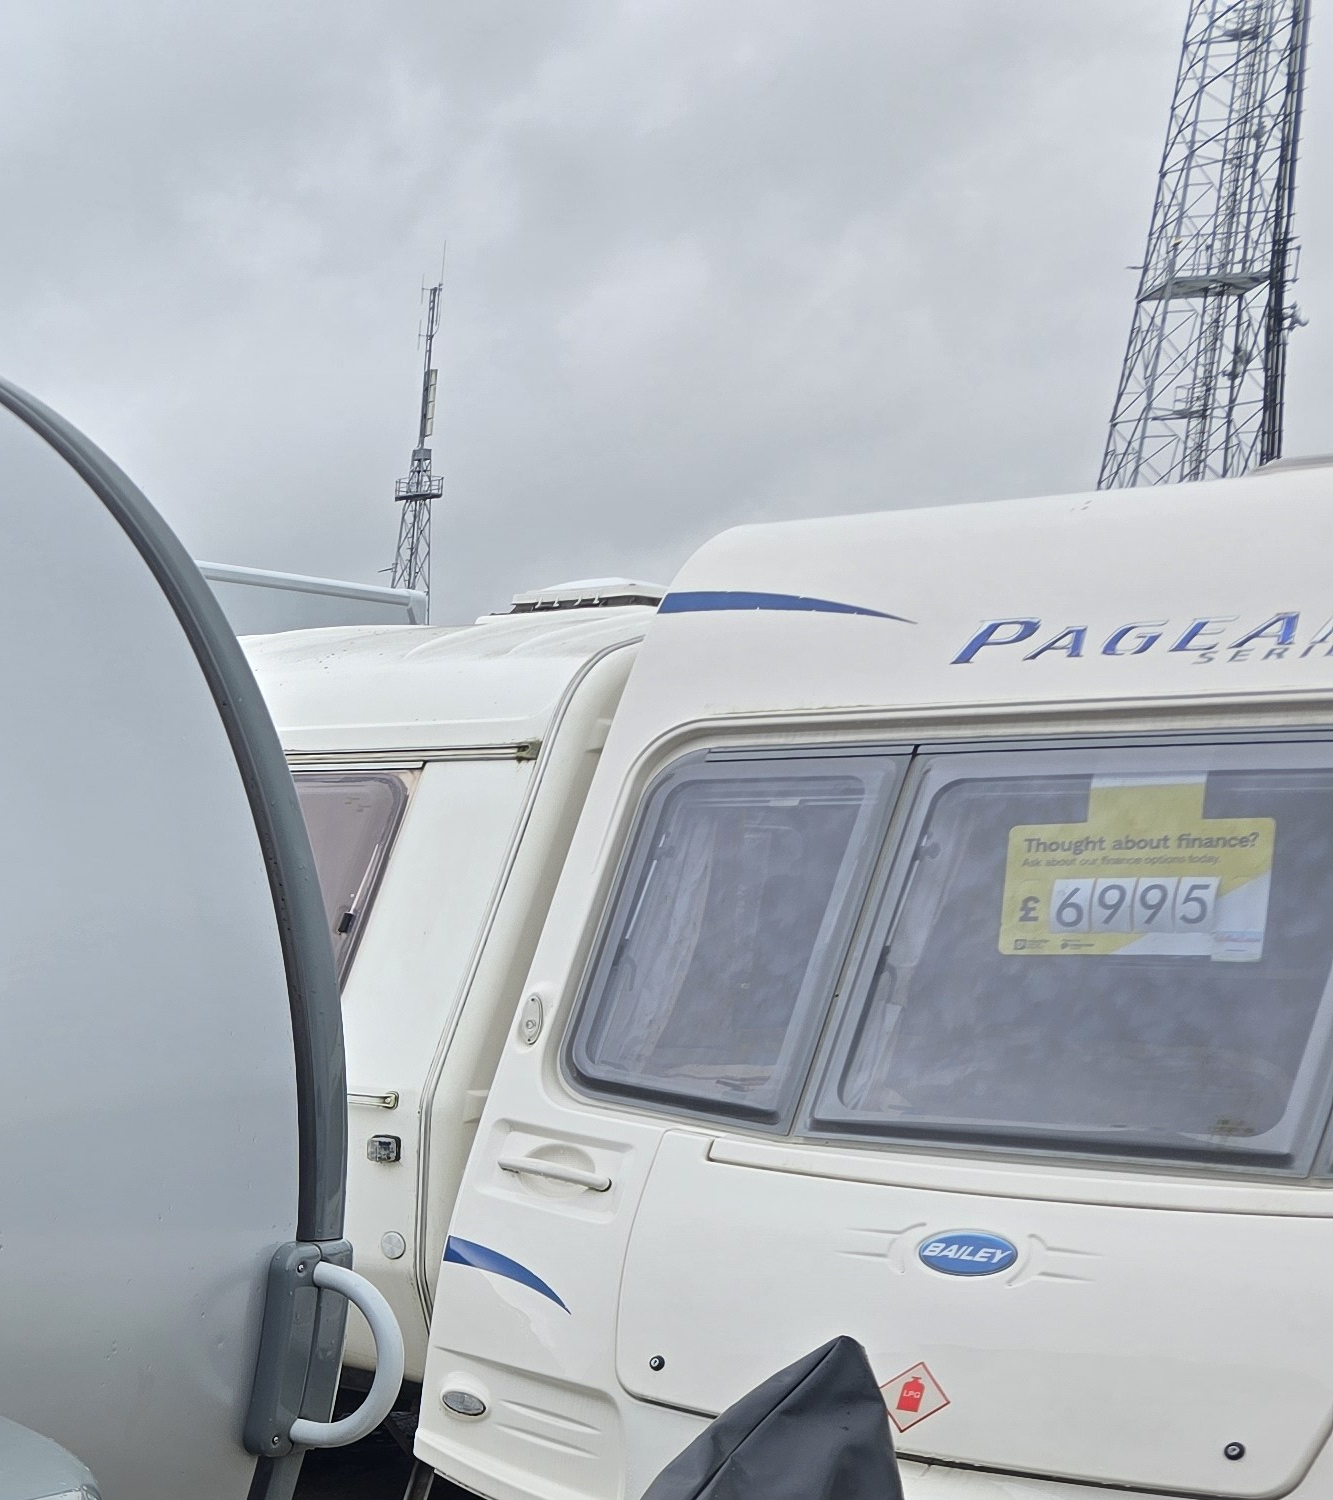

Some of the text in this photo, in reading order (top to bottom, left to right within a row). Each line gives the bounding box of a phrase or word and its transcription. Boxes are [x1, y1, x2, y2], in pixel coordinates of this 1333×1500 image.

[1024, 832, 1260, 855] Thought about finance?
[1021, 857, 1043, 867] Ask
[1045, 857, 1076, 867] about
[1100, 856, 1141, 866] finance
[1144, 855, 1185, 867] options
[1018, 883, 1212, 928] £ 6995
[923, 1243, 1012, 1264] BAILEY
[903, 1390, 921, 1398] LPG
